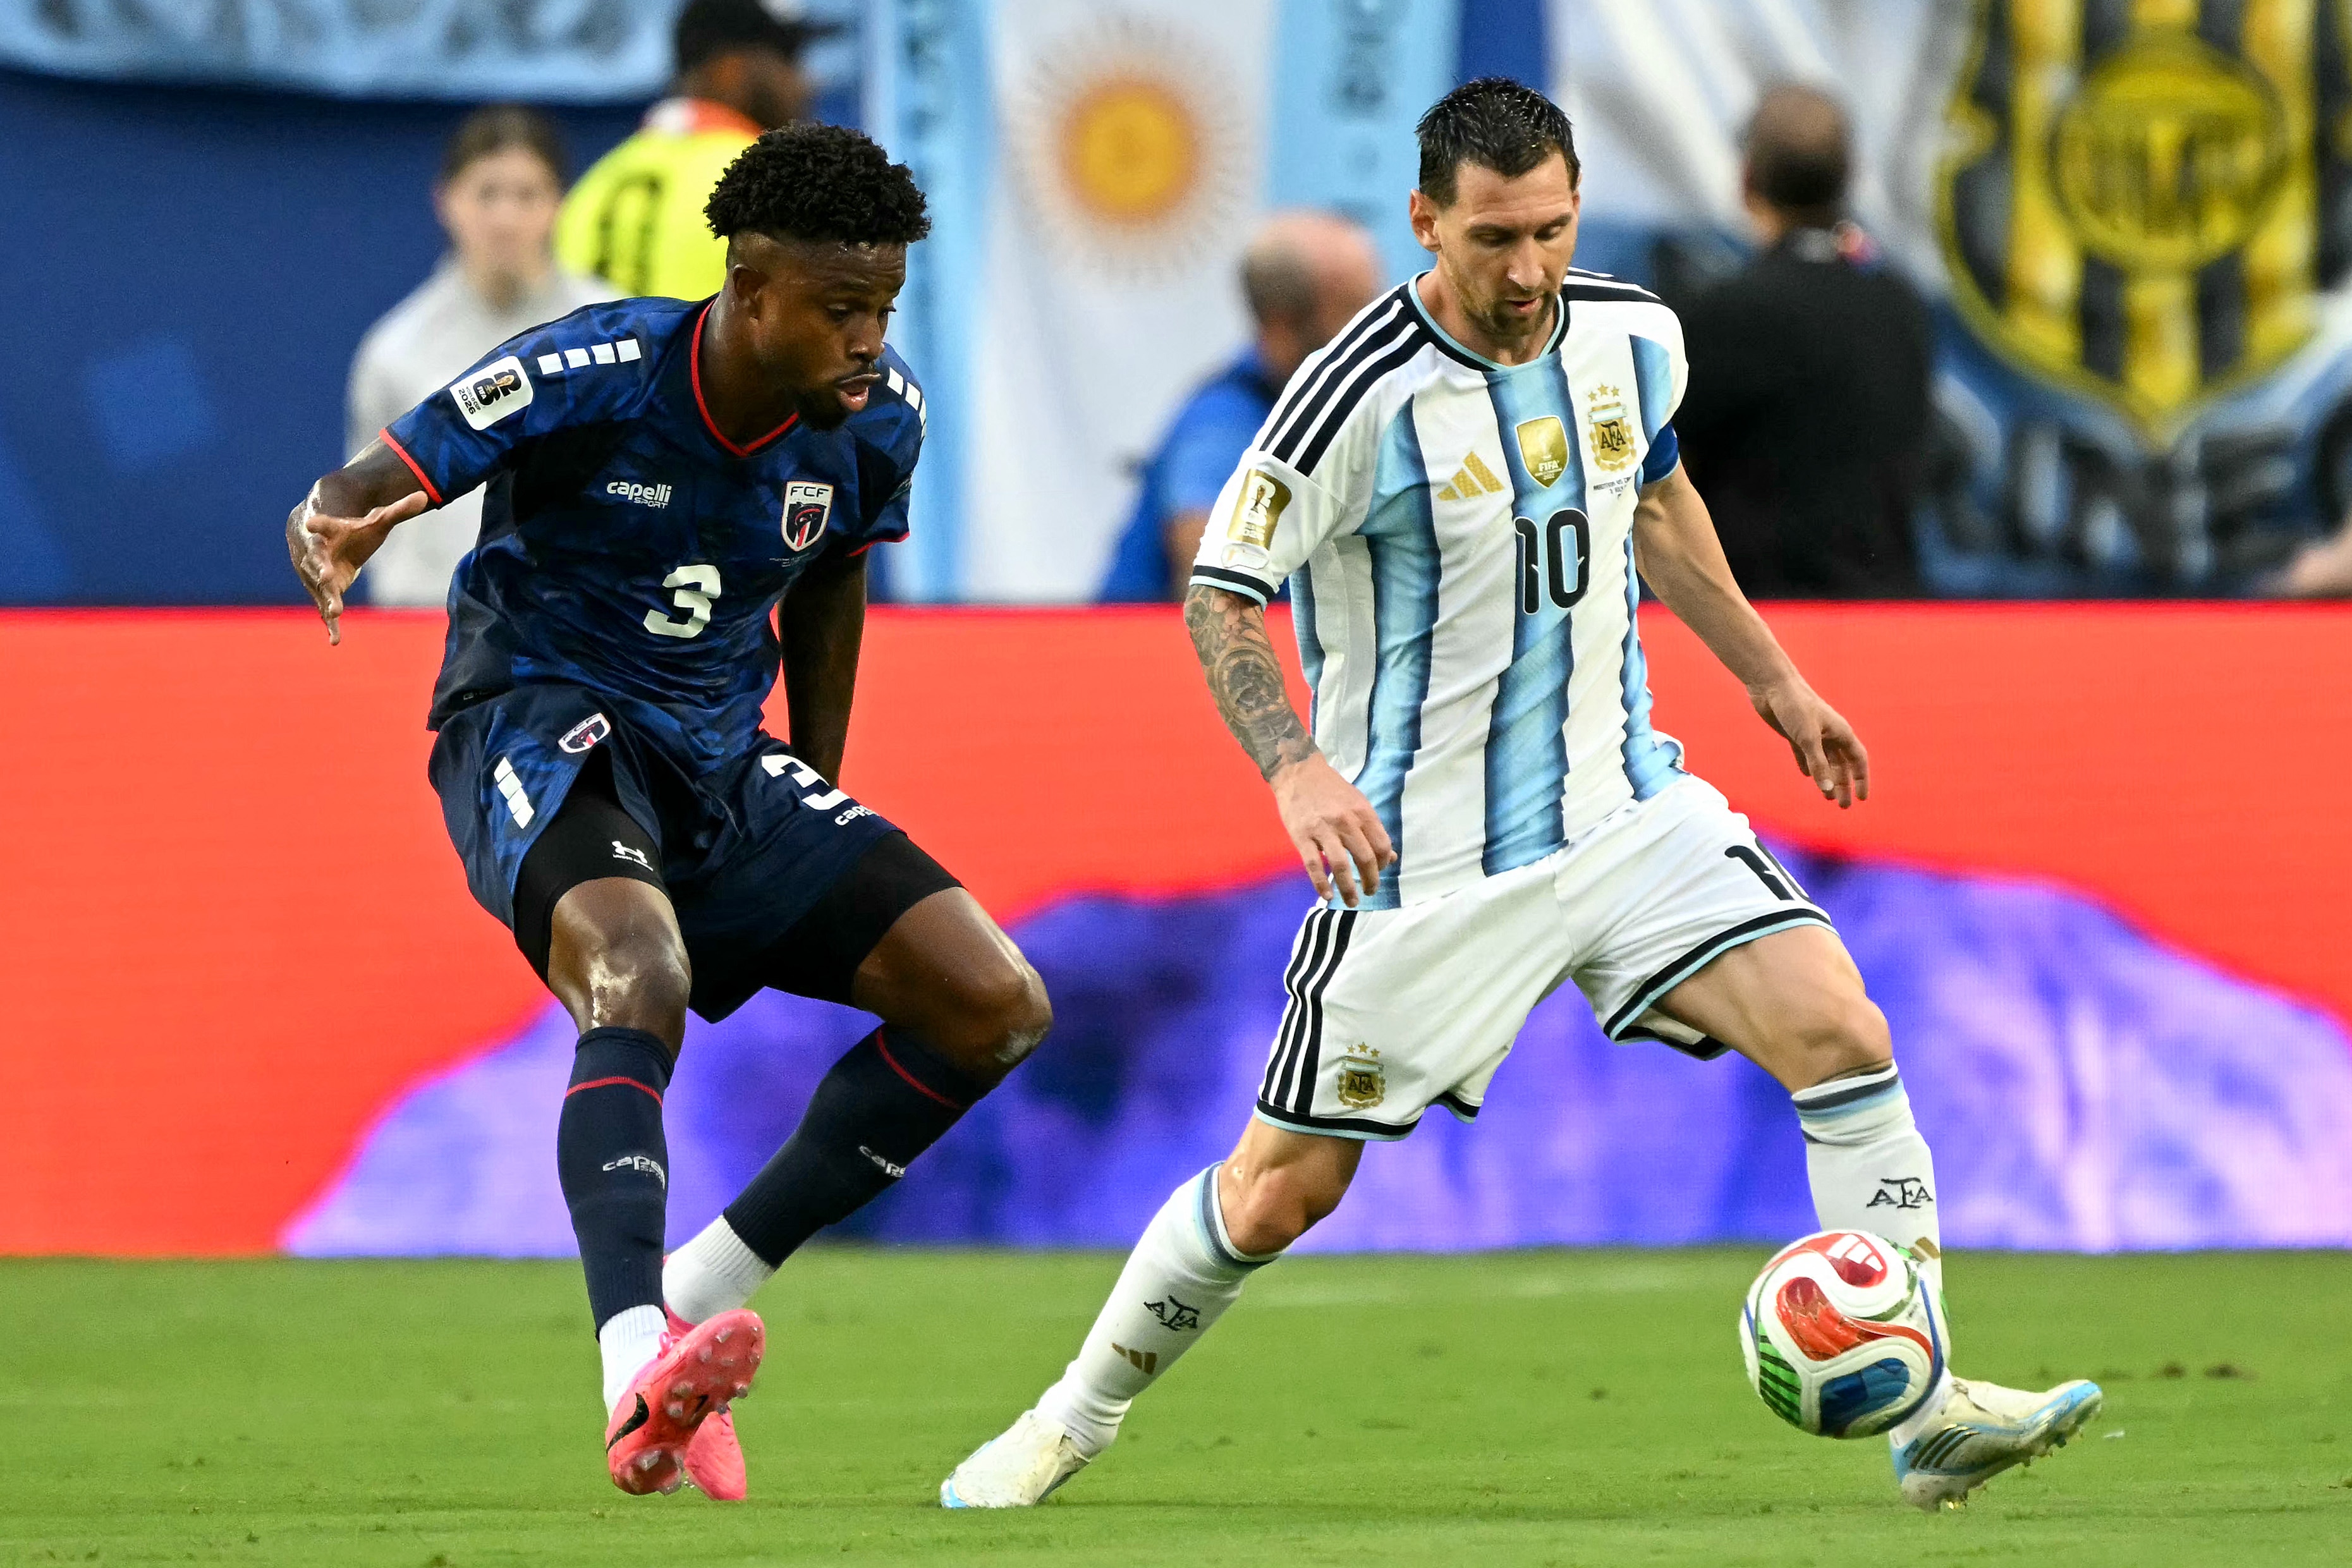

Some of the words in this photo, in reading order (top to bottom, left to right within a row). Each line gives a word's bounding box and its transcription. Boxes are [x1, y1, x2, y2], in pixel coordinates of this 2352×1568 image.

[458, 388, 476, 415] 2026
[477, 386, 487, 400] FIFA
[1600, 420, 1626, 452] AFA
[1538, 459, 1559, 472] FIFA
[607, 481, 672, 503] capelli
[633, 497, 668, 509] SPORT
[790, 486, 829, 498] FCF
[1514, 507, 1591, 616] 10
[643, 564, 722, 638] 3
[1348, 1072, 1376, 1095] AFA
[1865, 1177, 1934, 1209] AFA
[1143, 1294, 1200, 1331] AFA
